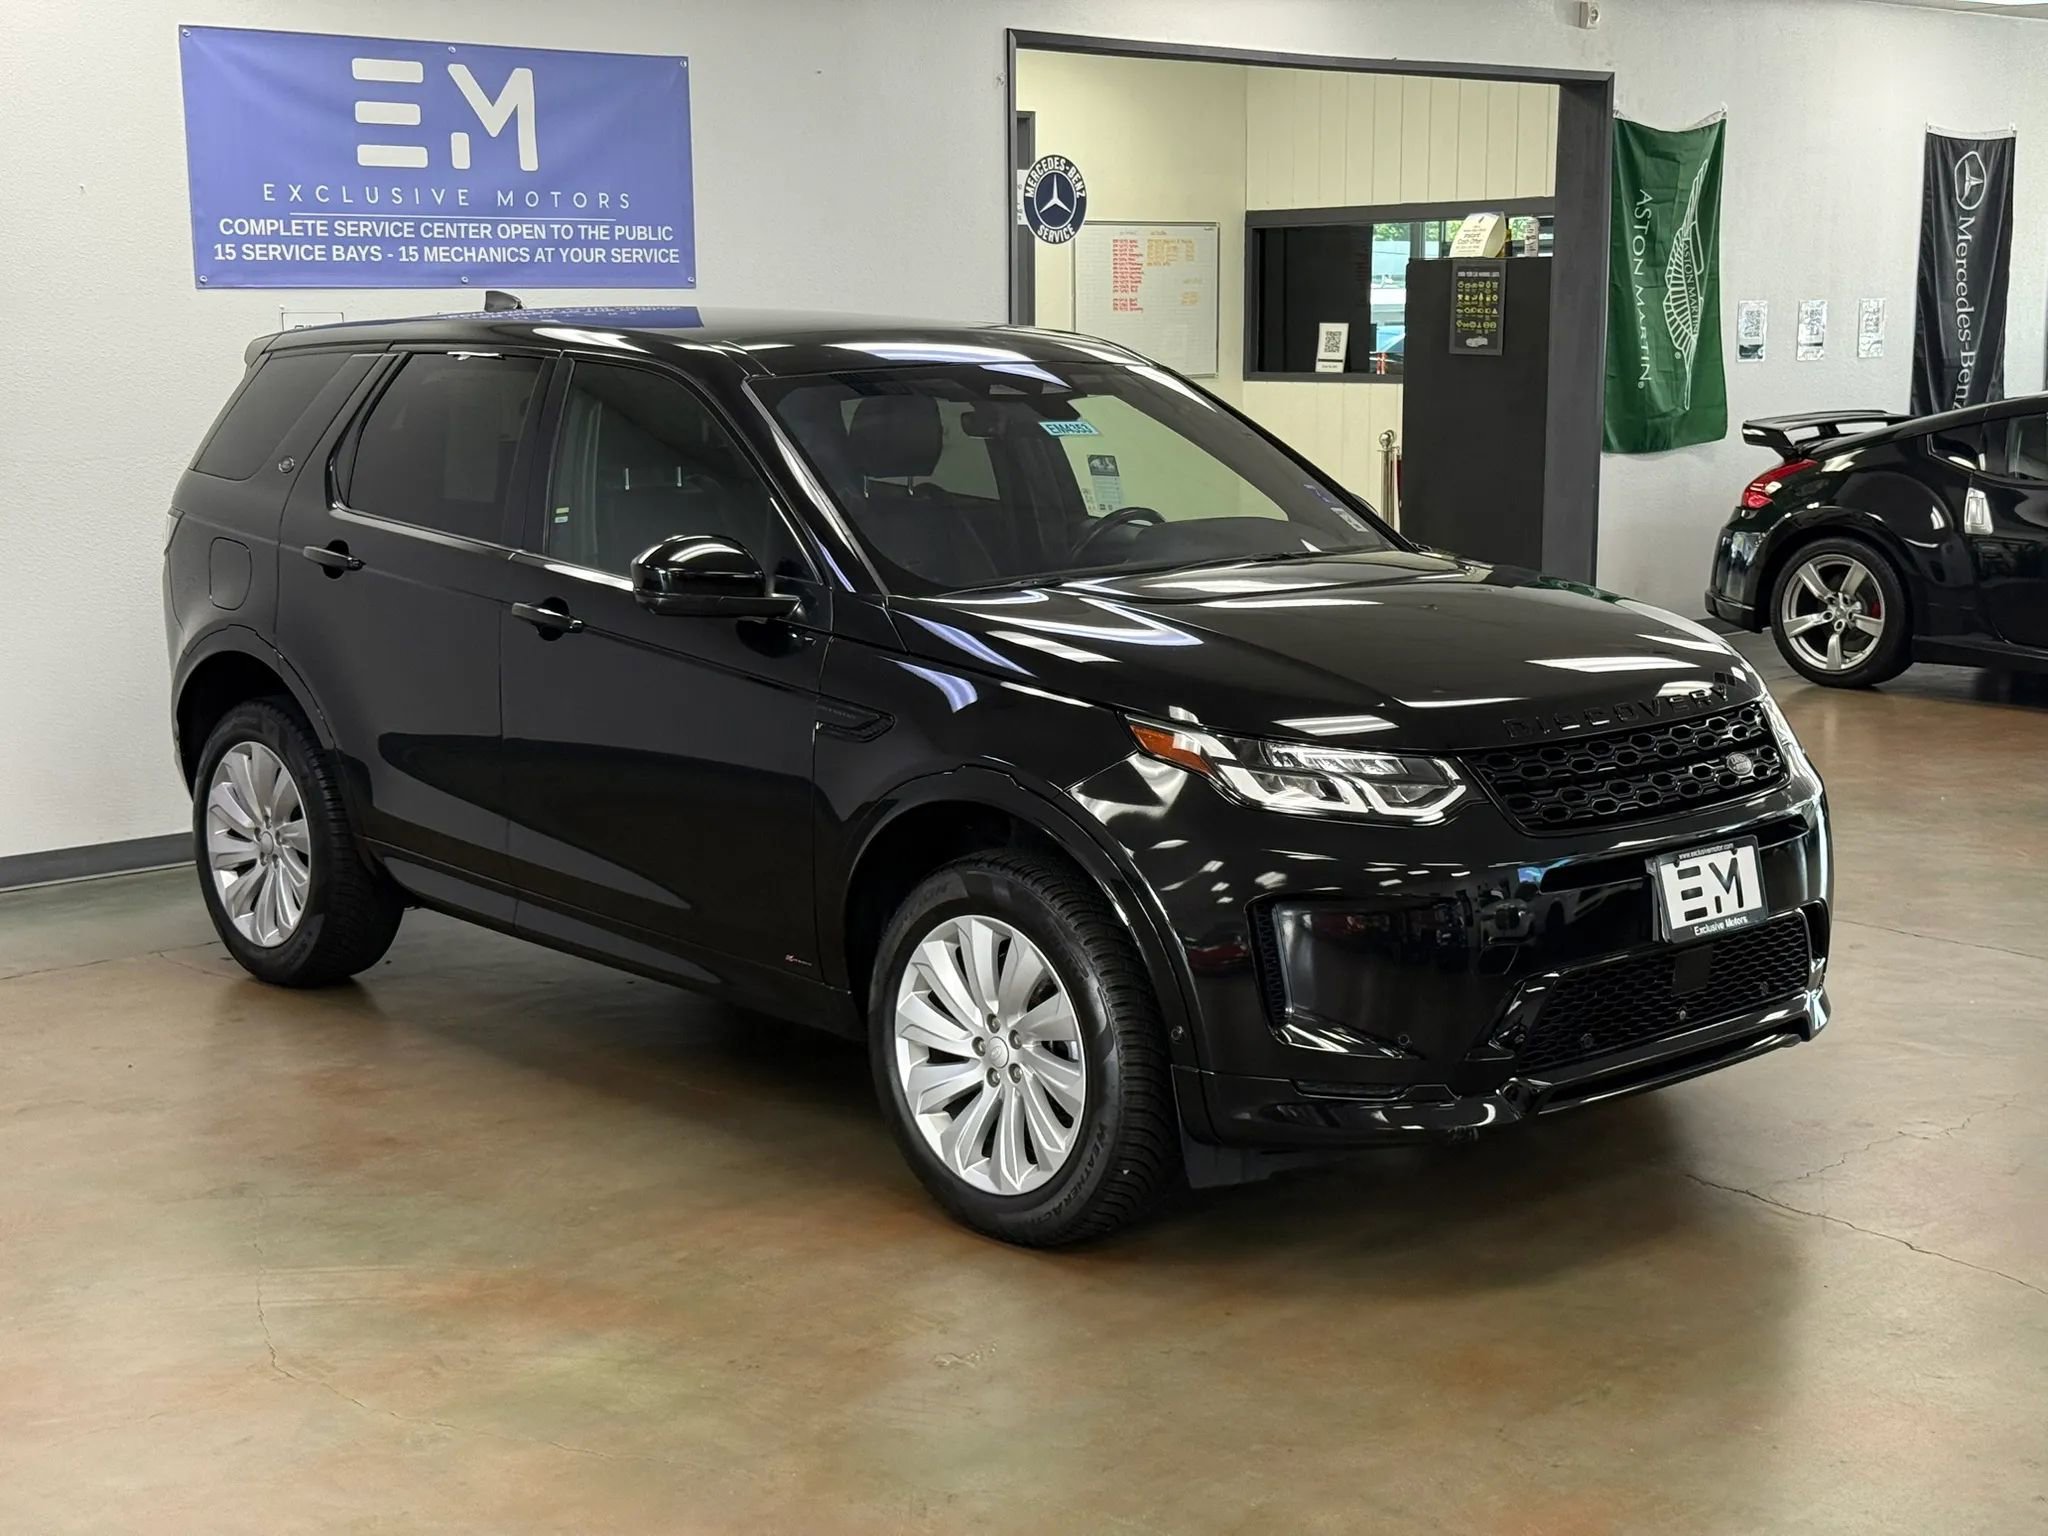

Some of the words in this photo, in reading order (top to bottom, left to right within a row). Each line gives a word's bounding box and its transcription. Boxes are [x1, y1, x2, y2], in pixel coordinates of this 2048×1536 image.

[263, 183, 469, 206] EXCLUSIVE
[497, 190, 630, 209] MOTORS
[1025, 156, 1086, 198] MERCEDES-BENZ
[219, 218, 328, 237] COMPLETE
[333, 220, 415, 238] SERVICE
[420, 221, 492, 239] CENTER
[497, 223, 546, 240] OPEN
[550, 224, 573, 240] TO
[578, 225, 610, 241] THE
[615, 225, 673, 241] PUBLIC
[1037, 223, 1075, 243] SERVICE
[1632, 189, 1653, 275] ASTON
[214, 244, 236, 261] 15
[241, 244, 327, 261] SERVICE
[332, 245, 382, 262] BAYS
[399, 246, 419, 262] 15
[424, 247, 530, 263] MECHANICS
[534, 248, 554, 263] AT
[559, 248, 606, 264] YOUR
[611, 249, 680, 264] SERVICE
[1682, 242, 1695, 283] ASTON
[1687, 284, 1700, 335] MARTIN
[1634, 284, 1652, 381] MARTIN
[1502, 684, 1729, 739] DISCOVERY
[1694, 920, 1725, 936] Exclusive
[1724, 915, 1748, 928] Motors
